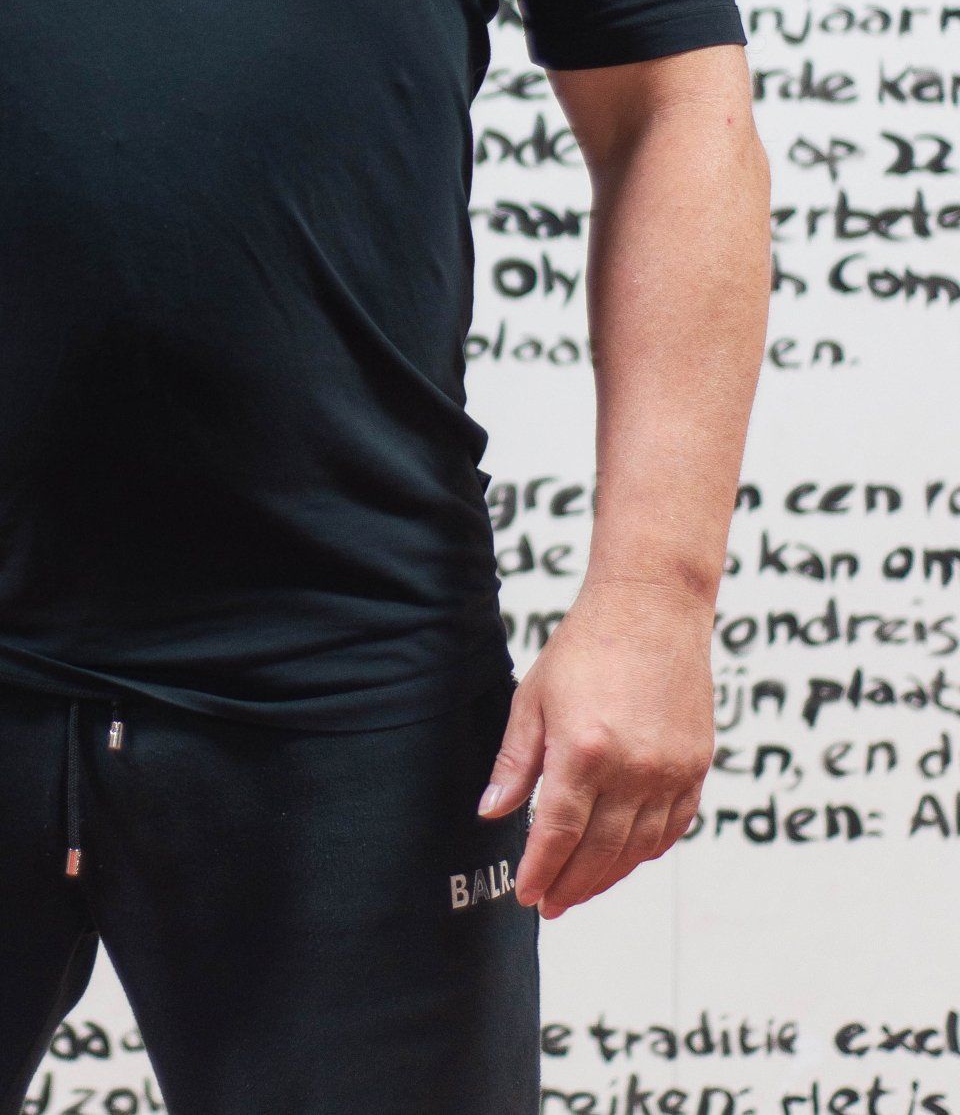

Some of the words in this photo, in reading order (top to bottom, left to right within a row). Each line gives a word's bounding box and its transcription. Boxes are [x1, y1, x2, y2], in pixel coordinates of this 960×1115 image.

[787, 136, 864, 184] op
[880, 130, 956, 178] 22
[768, 339, 862, 368] en.
[783, 481, 903, 517] een
[758, 530, 861, 584] kan
[820, 740, 899, 780] en
[449, 859, 515, 909] BALR.
[587, 1010, 799, 1065] traditie
